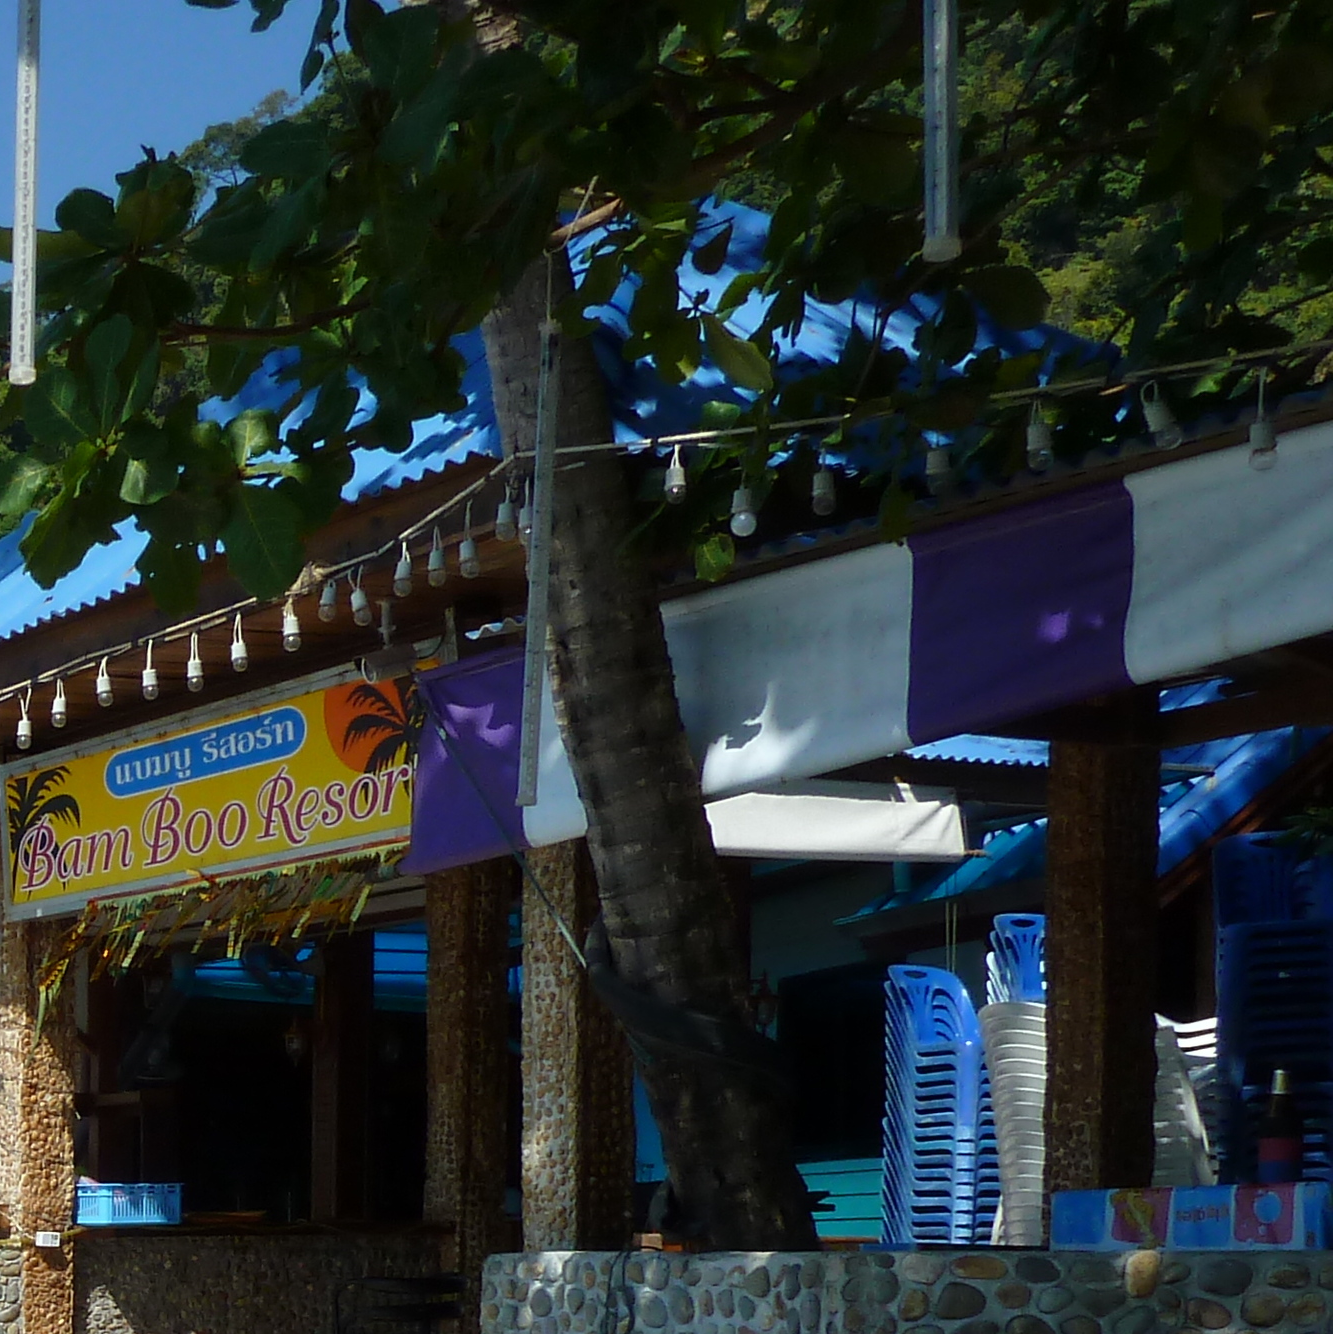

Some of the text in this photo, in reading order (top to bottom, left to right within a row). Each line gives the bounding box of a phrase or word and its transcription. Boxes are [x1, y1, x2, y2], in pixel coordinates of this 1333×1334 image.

[115, 717, 296, 779] แบมบู รีสอร์ท
[20, 764, 413, 891] Bam Boo Resor
